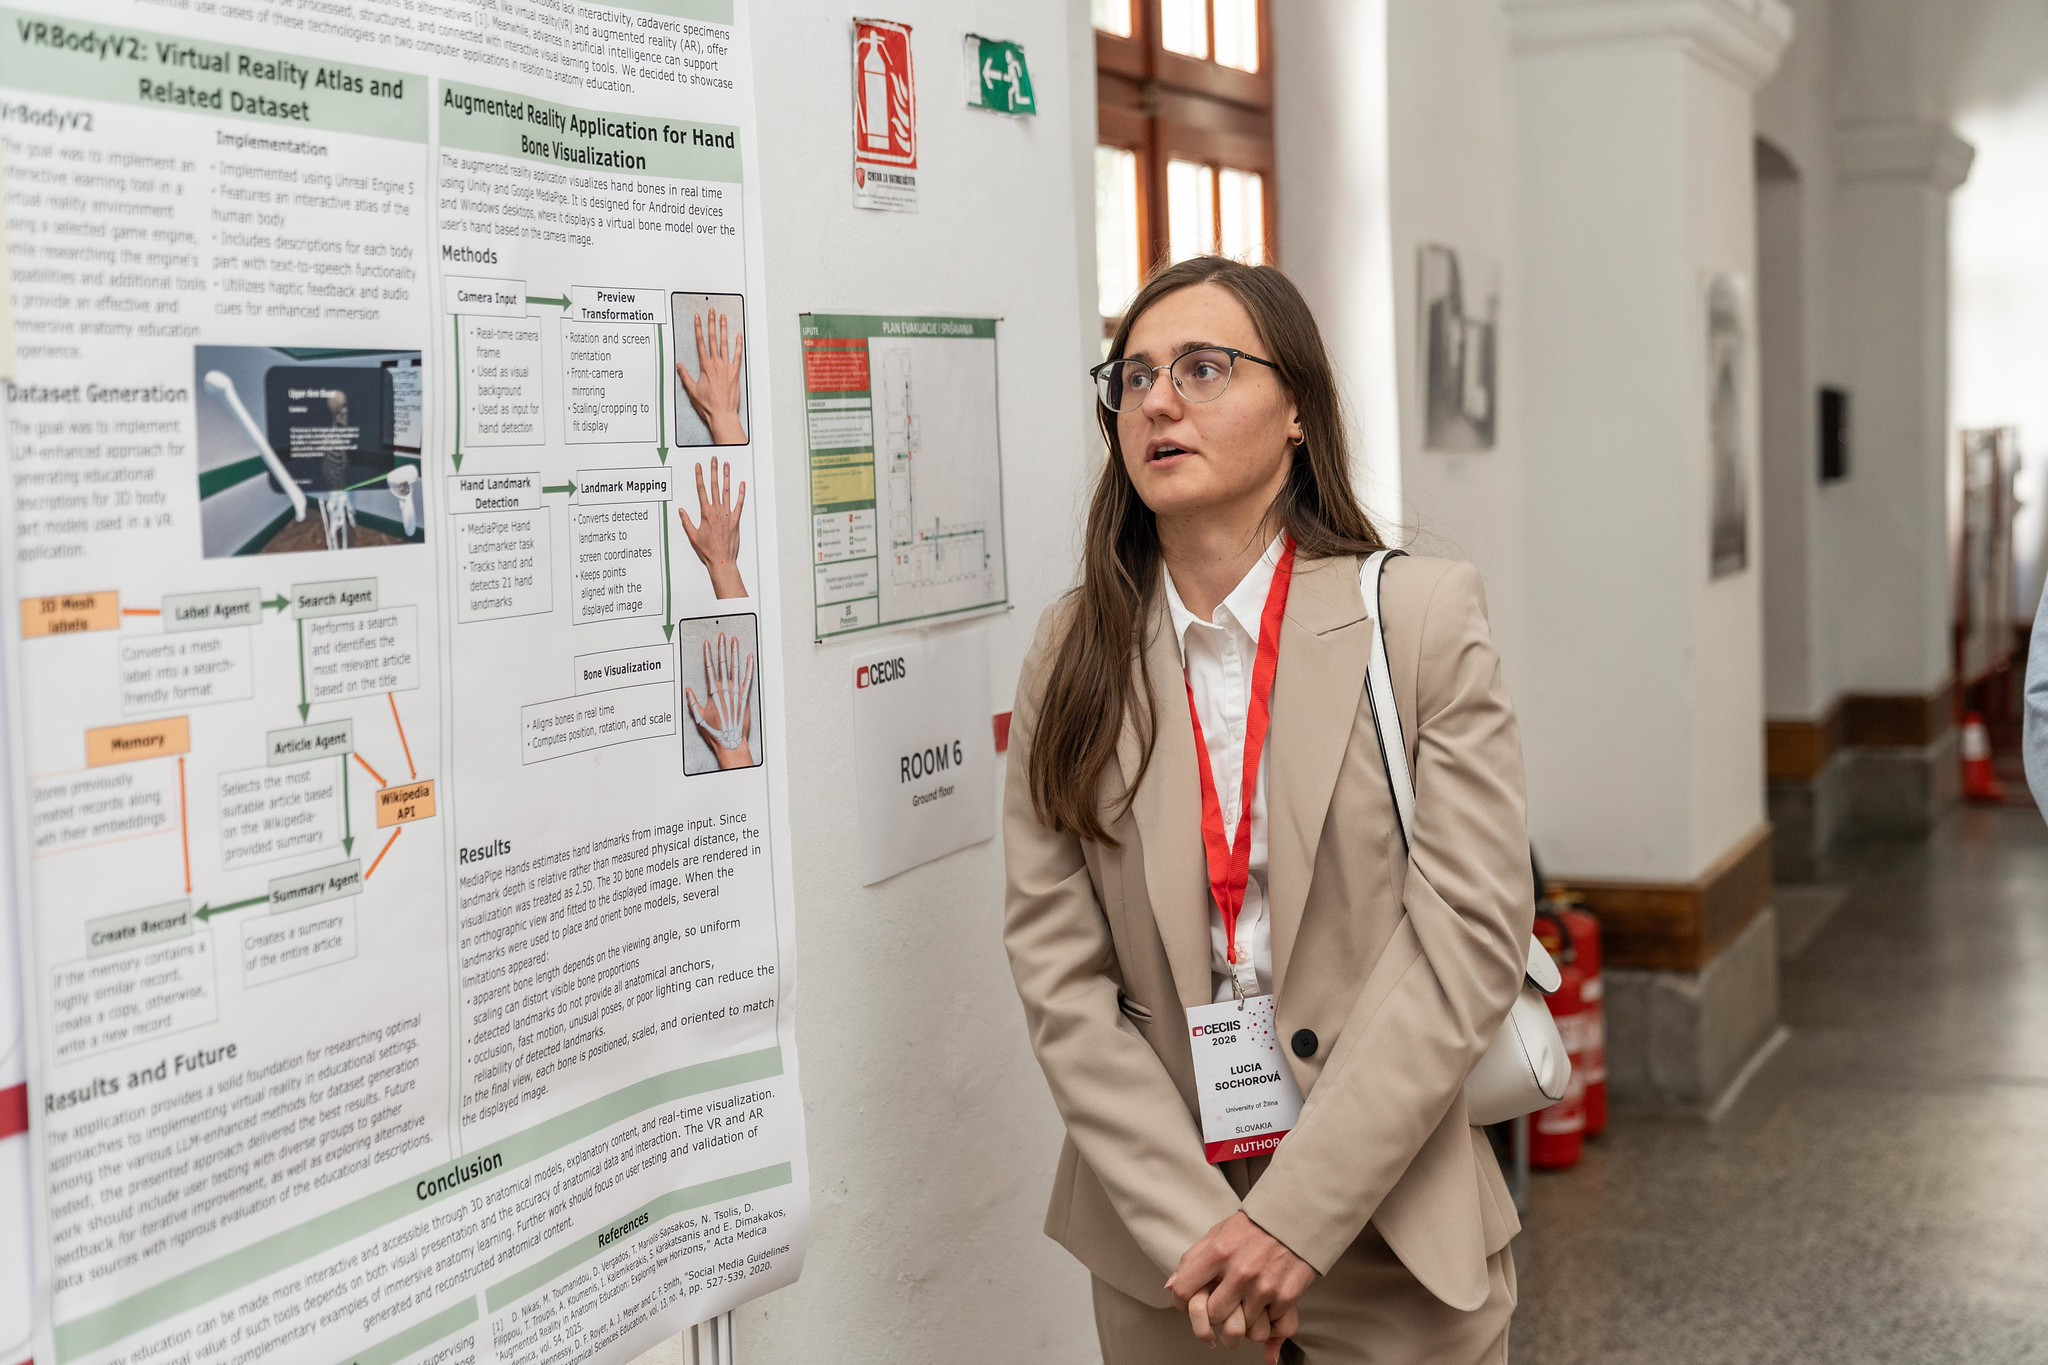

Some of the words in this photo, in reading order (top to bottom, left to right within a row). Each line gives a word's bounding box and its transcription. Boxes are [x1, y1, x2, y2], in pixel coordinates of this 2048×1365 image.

[577, 5, 633, 27] interactivity,
[637, 17, 680, 32] cadaveric
[683, 24, 729, 40] specimens
[592, 27, 644, 44] augmented
[648, 36, 677, 51] reality
[680, 38, 703, 54] (AR),
[707, 43, 728, 55] offer
[17, 20, 147, 60] VRBodyV2:
[156, 42, 230, 73] Virtual
[238, 54, 308, 90] Reality
[315, 67, 363, 93] Atlas
[370, 79, 402, 99] and
[608, 45, 661, 63] intelligence
[664, 55, 680, 65] can
[684, 58, 718, 71] support
[586, 77, 634, 93] education.
[621, 64, 636, 76] We
[639, 66, 674, 81] decided
[677, 72, 687, 83] to
[690, 73, 733, 89] showcase
[139, 78, 222, 109] Related
[230, 91, 309, 121] Dataset
[444, 88, 523, 120] Augmented
[527, 104, 566, 134] Reality
[570, 114, 657, 141] Application
[662, 125, 686, 144] for
[693, 128, 734, 148] Hand
[217, 130, 327, 156] Implementation
[521, 134, 549, 157] Bone
[552, 141, 645, 169] Visualization
[610, 179, 633, 192] hand
[637, 181, 665, 194] bones
[669, 184, 677, 195] in
[681, 186, 698, 197] real
[702, 186, 722, 199] time
[590, 196, 629, 212] designed
[632, 199, 645, 211] for
[648, 201, 685, 214] Android
[688, 204, 723, 217] devices
[606, 217, 635, 229] virtual
[638, 218, 661, 231] bone
[665, 221, 693, 233] model
[696, 225, 717, 234] over
[720, 224, 735, 235] the
[568, 232, 593, 247] image.
[442, 245, 497, 264] Methods
[457, 290, 492, 303] Camera
[495, 292, 516, 305] Input
[597, 291, 635, 302] Preview
[581, 308, 653, 320] Transformation
[570, 331, 599, 343] Rotation
[602, 333, 618, 344] and
[622, 335, 650, 344] screen
[803, 327, 819, 336] UPUTE
[883, 322, 900, 334] PLAN
[571, 350, 611, 361] orientation
[571, 367, 623, 378] Front-camera
[572, 385, 605, 398] mirroring
[572, 402, 637, 416] Scaling/cropping
[640, 403, 649, 413] to
[460, 479, 484, 490] Hand
[487, 477, 530, 489] Landmark
[581, 481, 623, 493] Landmark
[626, 479, 666, 493] Mapping
[475, 496, 518, 509] Detection
[578, 513, 609, 524] Converts
[612, 509, 648, 522] detected
[298, 593, 335, 608] Search
[335, 590, 371, 606] Agent
[175, 605, 209, 620] Label
[214, 602, 249, 618] Agent
[583, 670, 602, 680] Bone
[604, 660, 661, 676] Visualization
[871, 657, 906, 686] CECIIS
[631, 715, 646, 727] and
[649, 712, 671, 724] scale
[275, 738, 311, 754] Article
[315, 732, 346, 749] Agent
[901, 745, 948, 783] ROOM
[953, 740, 962, 765] 6
[380, 786, 429, 805] Wikipedia
[913, 789, 937, 807] Ground
[939, 786, 954, 800] floor
[397, 805, 415, 819] API
[654, 823, 683, 836] image
[687, 817, 715, 831] input.
[720, 813, 746, 825] Since
[693, 832, 738, 847] distance,
[742, 828, 759, 839] the
[460, 839, 510, 865] Results
[702, 845, 747, 863] rendered
[751, 845, 761, 855] in
[272, 882, 325, 903] Summary
[328, 872, 358, 890] Agent
[683, 885, 719, 902] several
[92, 926, 136, 945] Create
[140, 912, 186, 933] Record
[700, 919, 740, 934] uniform
[670, 959, 714, 975] anchors,
[718, 969, 753, 983] reduce
[757, 965, 774, 976] the
[681, 1006, 724, 1025] oriented
[729, 1006, 739, 1016] to
[743, 997, 774, 1013] match
[1204, 1021, 1241, 1035] CECIIS
[1212, 1035, 1237, 1045] 2026
[1230, 1062, 1262, 1075] LUCIA
[44, 1077, 119, 1116] Results
[127, 1060, 166, 1088] and
[174, 1043, 236, 1075] Future
[1215, 1070, 1281, 1090] SOCHOROVÁ
[658, 1106, 703, 1126] real-time
[706, 1090, 774, 1112] visualization.
[1226, 1103, 1254, 1113] University
[684, 1123, 703, 1135] The
[706, 1117, 722, 1129] VR
[725, 1111, 744, 1125] and
[749, 1107, 763, 1120] AR
[1235, 1122, 1272, 1133] SLOVAKIA
[692, 1131, 743, 1151] validation
[747, 1125, 758, 1138] of
[1233, 1138, 1281, 1154] AUTHOR
[416, 1151, 503, 1200] Conclusion
[701, 1214, 710, 1224] N.
[714, 1207, 741, 1220] Tsolis,
[744, 1203, 753, 1212] D.
[735, 1209, 785, 1228] Dimakakos,
[598, 1212, 648, 1248] References
[714, 1235, 733, 1247] Acta
[737, 1226, 766, 1241] Medica
[684, 1264, 715, 1280] "Social
[718, 1258, 743, 1272] Media
[747, 1244, 789, 1263] Guidelines
[749, 1261, 772, 1275] 2020.
